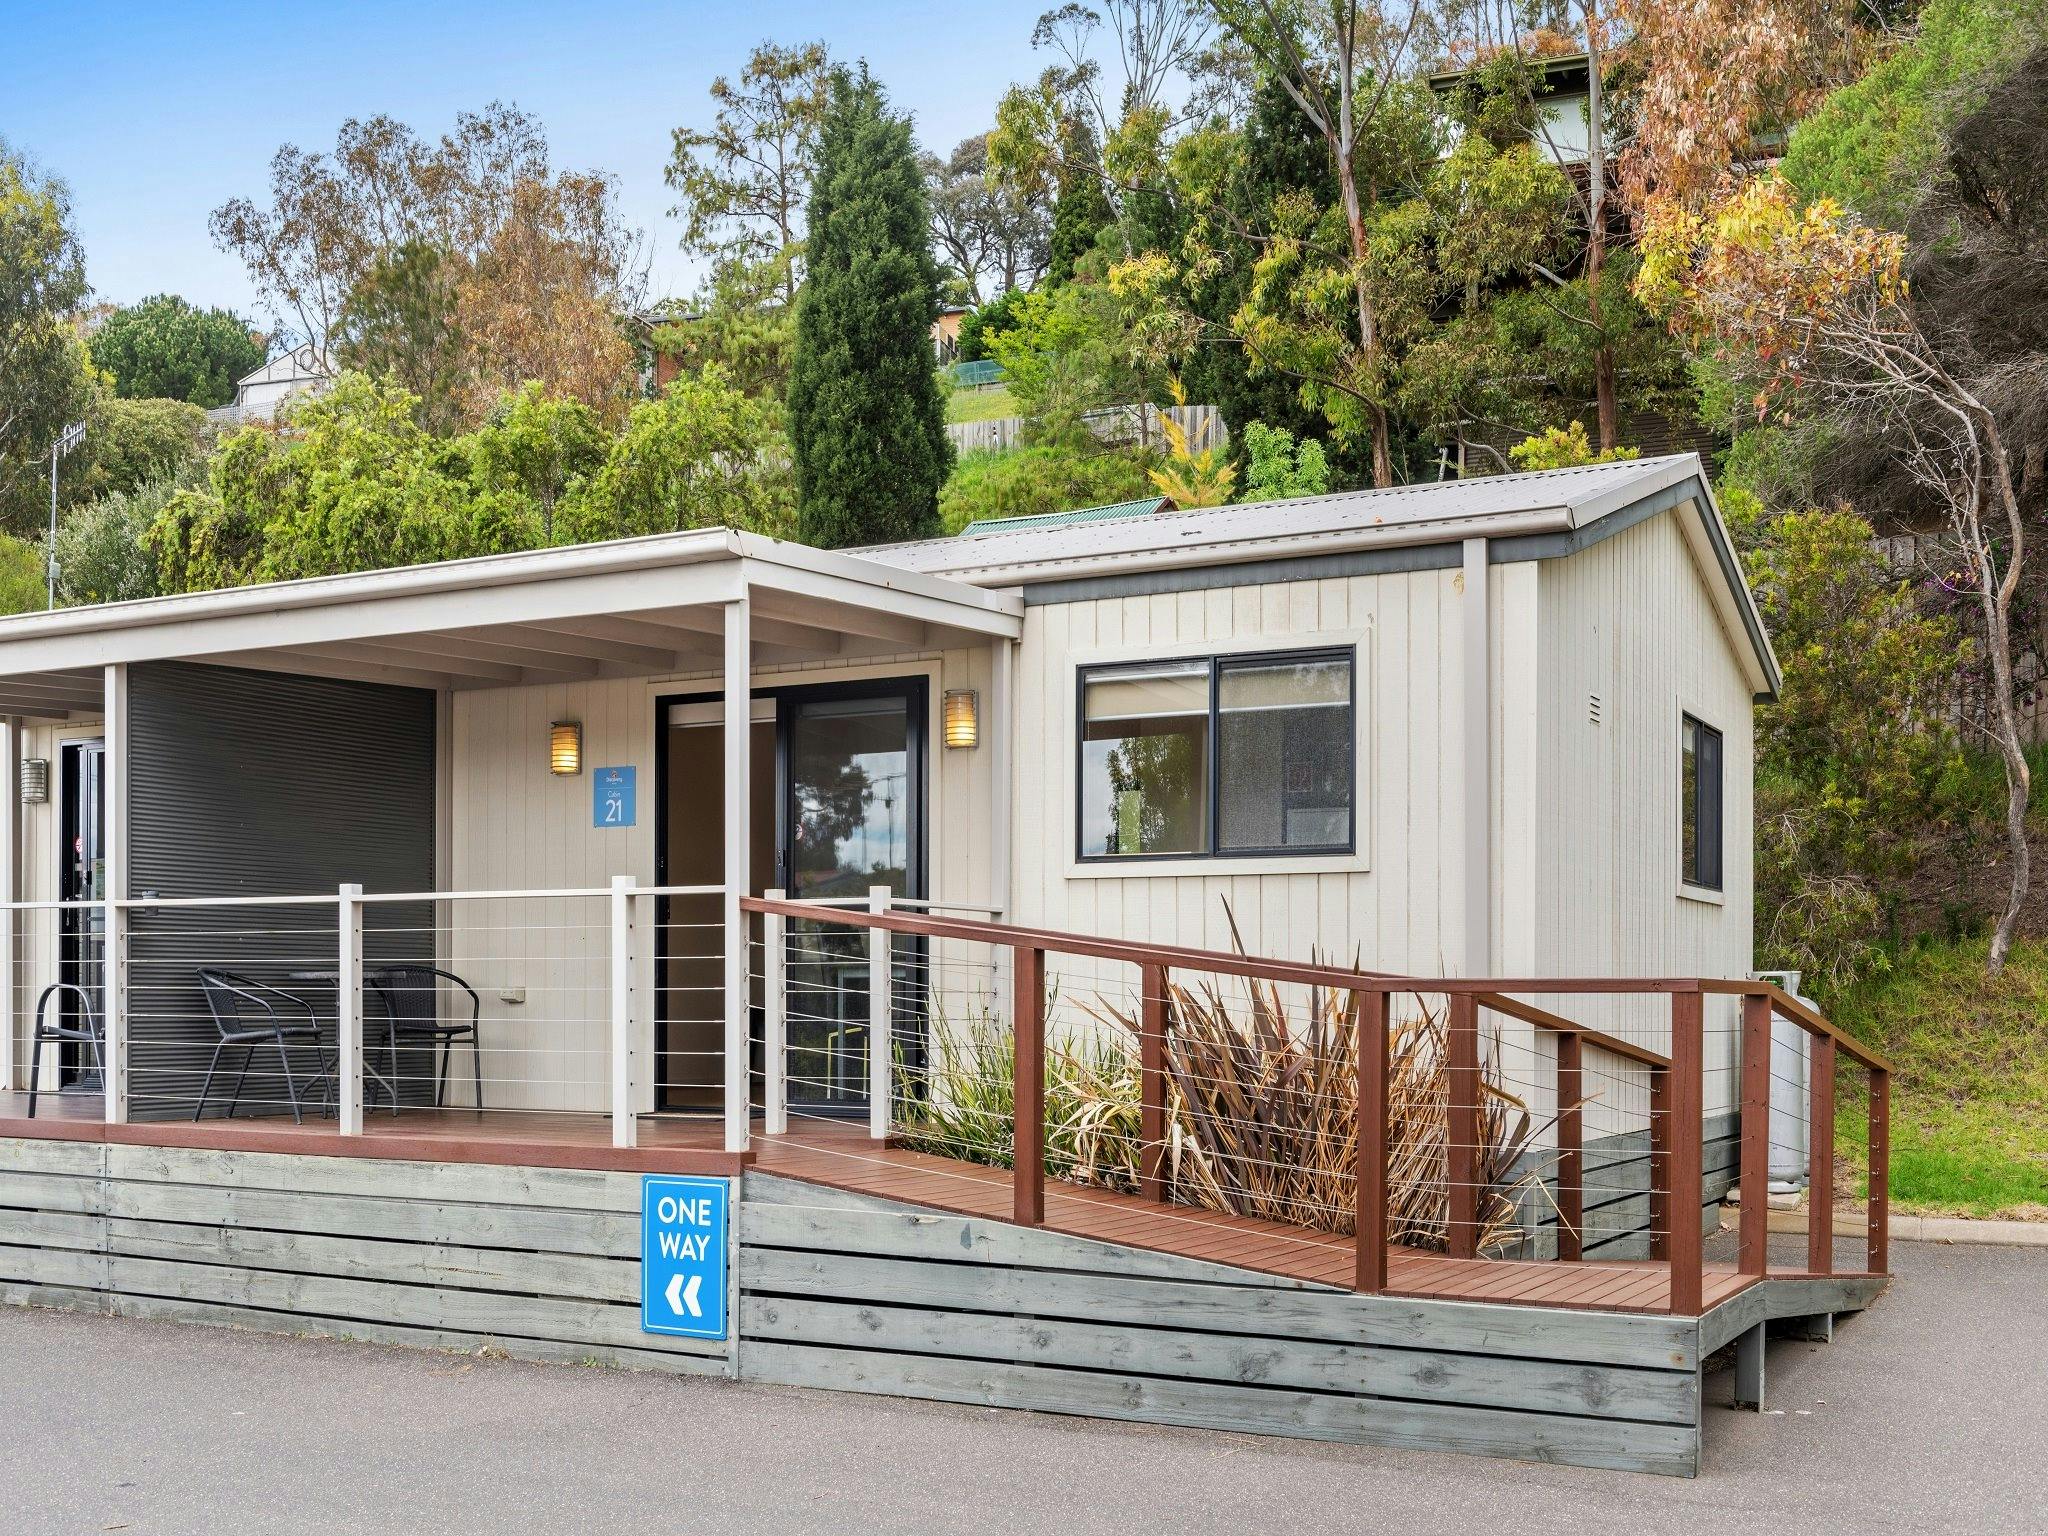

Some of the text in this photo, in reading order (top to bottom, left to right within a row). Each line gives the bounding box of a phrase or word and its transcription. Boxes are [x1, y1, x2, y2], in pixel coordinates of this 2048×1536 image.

[605, 799, 622, 822] 21
[657, 1196, 712, 1226] ONE
[658, 1231, 711, 1262] WAY
